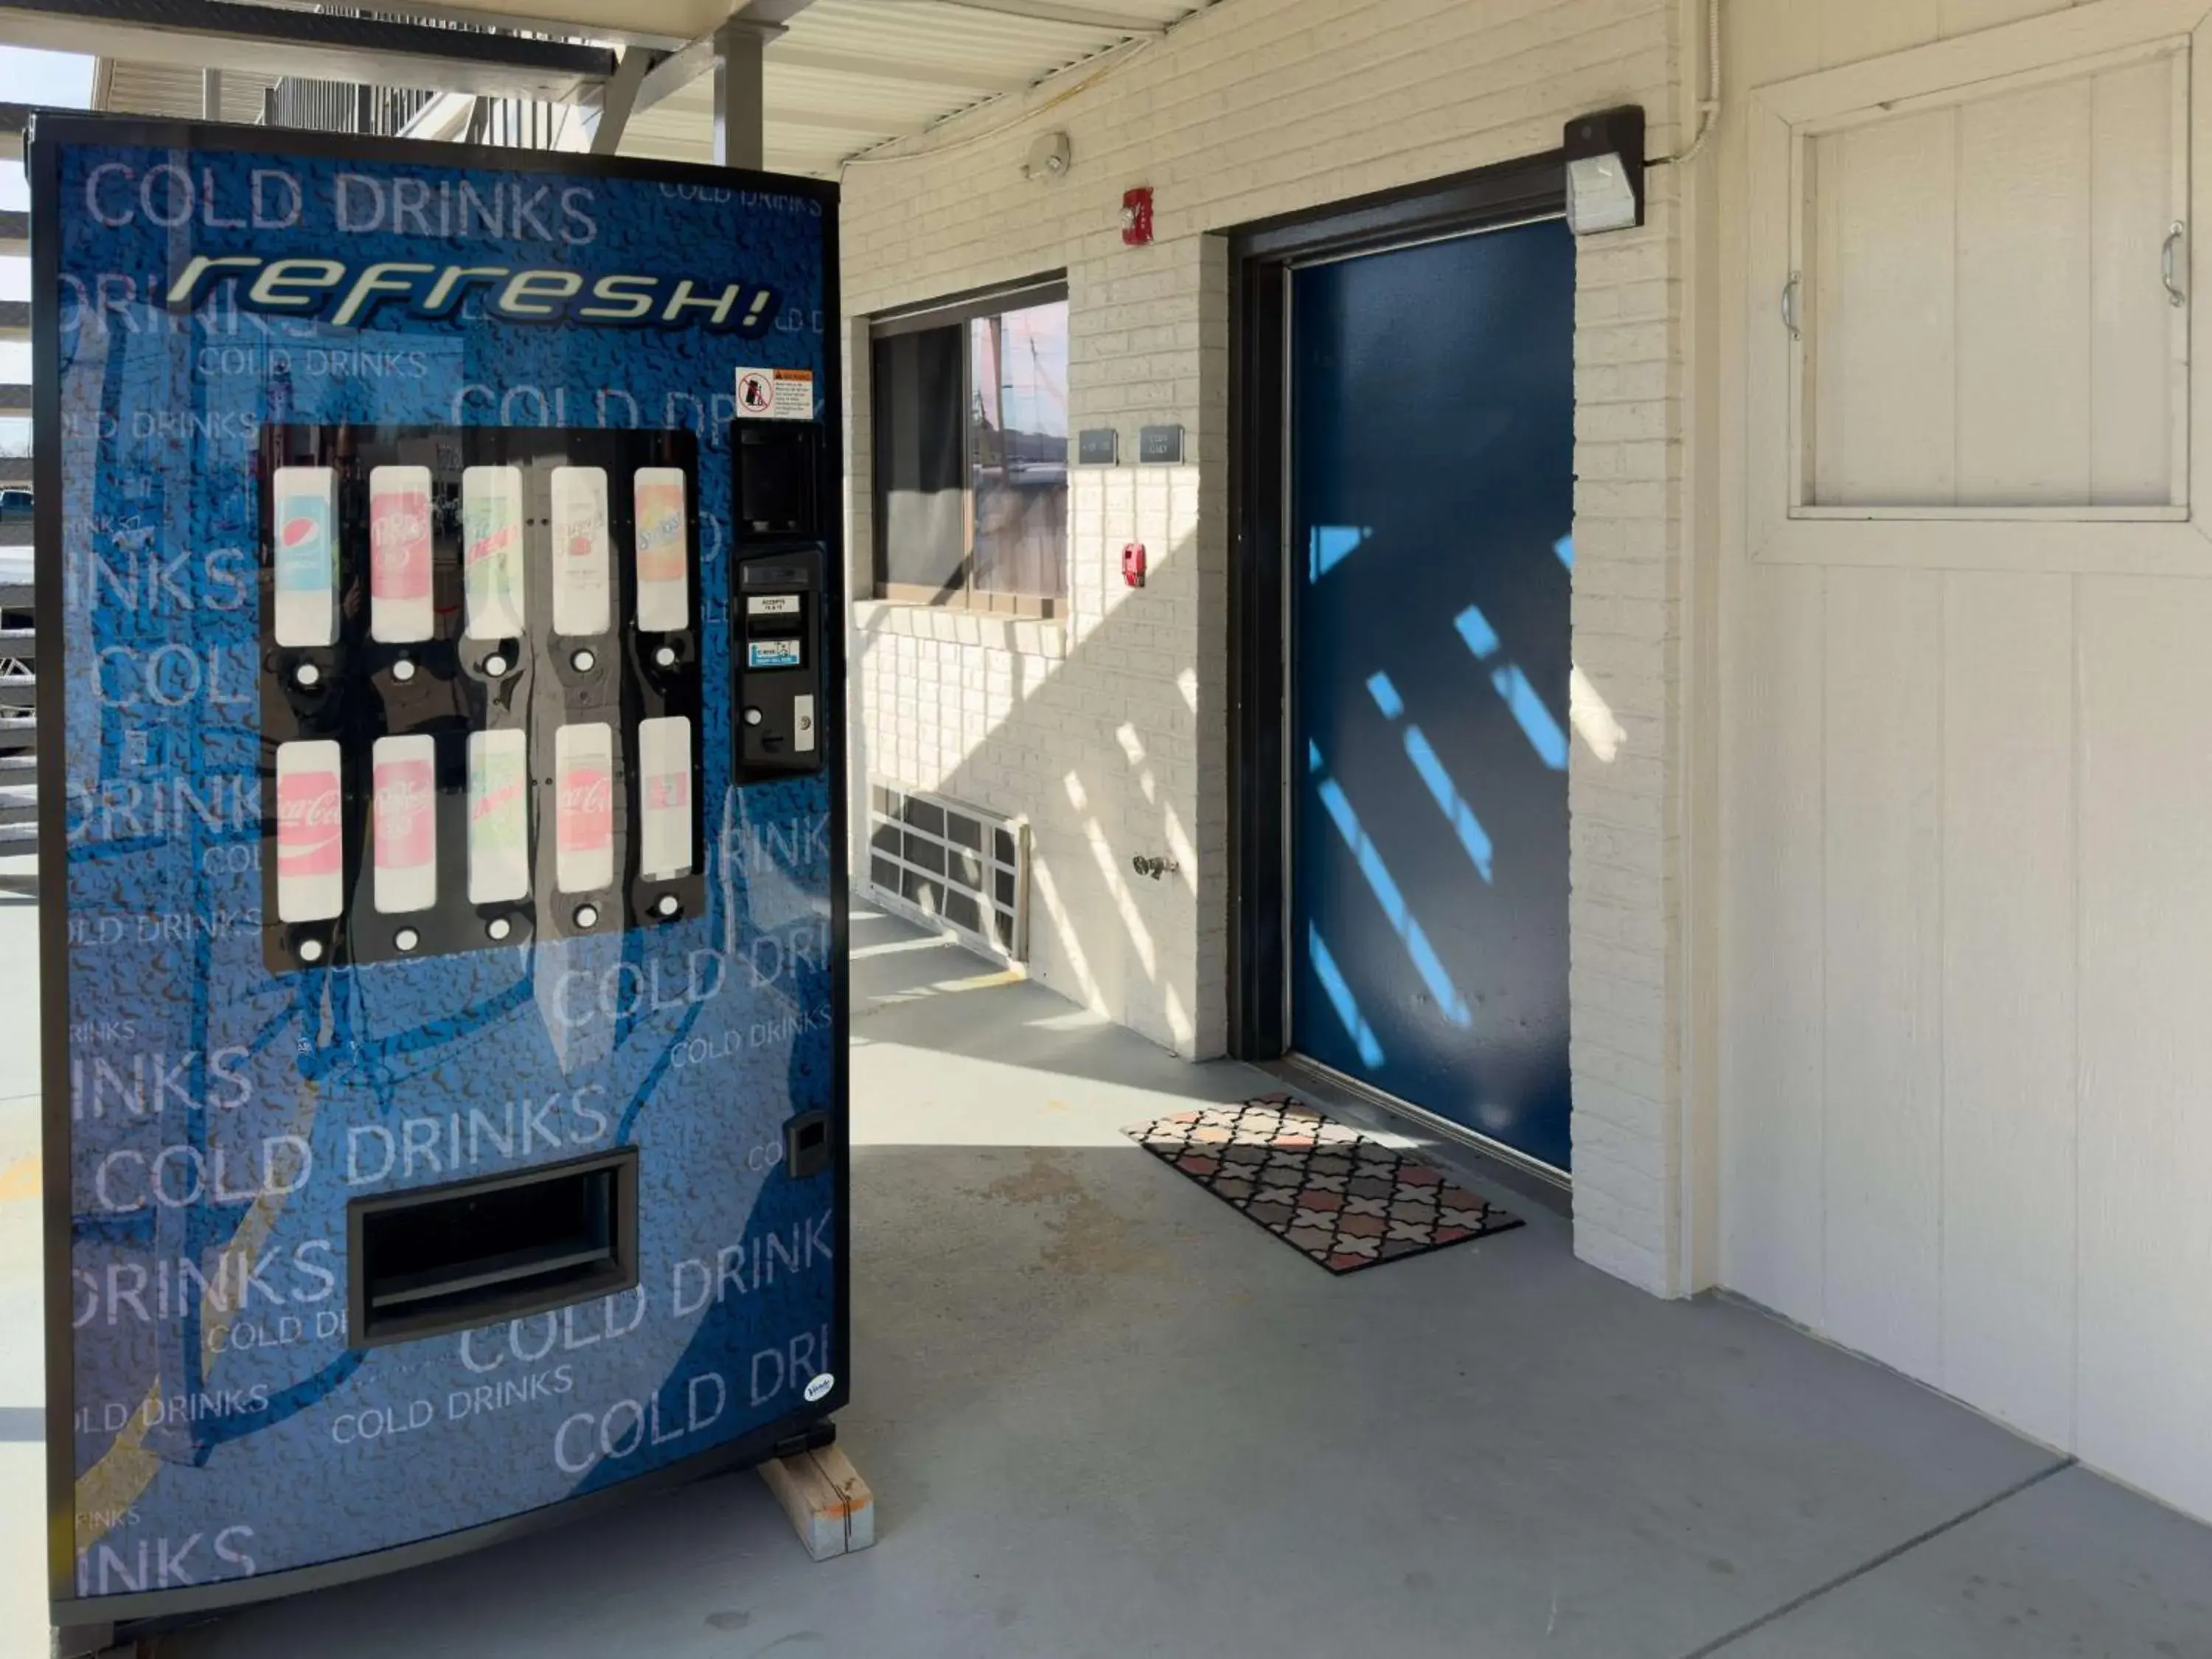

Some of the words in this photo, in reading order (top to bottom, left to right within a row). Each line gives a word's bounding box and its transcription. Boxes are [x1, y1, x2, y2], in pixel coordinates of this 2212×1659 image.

[84, 162, 302, 229] COLD
[335, 173, 598, 246] DRINKS
[197, 347, 290, 375] COLD
[306, 348, 428, 379] DRINKS
[133, 411, 260, 439] DRINKS
[90, 643, 251, 706] COL
[138, 908, 262, 945] DRINKS
[552, 948, 726, 1029] COLD
[670, 1031, 739, 1068] COLD
[750, 1004, 832, 1047] DRINKS
[73, 1045, 254, 1119] INKS
[96, 1135, 313, 1213] COLD
[346, 1084, 608, 1186] DRINKS
[208, 1316, 302, 1354] COLD
[460, 1281, 646, 1374] COLD
[142, 1382, 269, 1426] DRINKS
[332, 1399, 433, 1444] COLD
[447, 1364, 574, 1422] DRINKS
[554, 1371, 727, 1473] COLD
[77, 1524, 257, 1597] INKS
